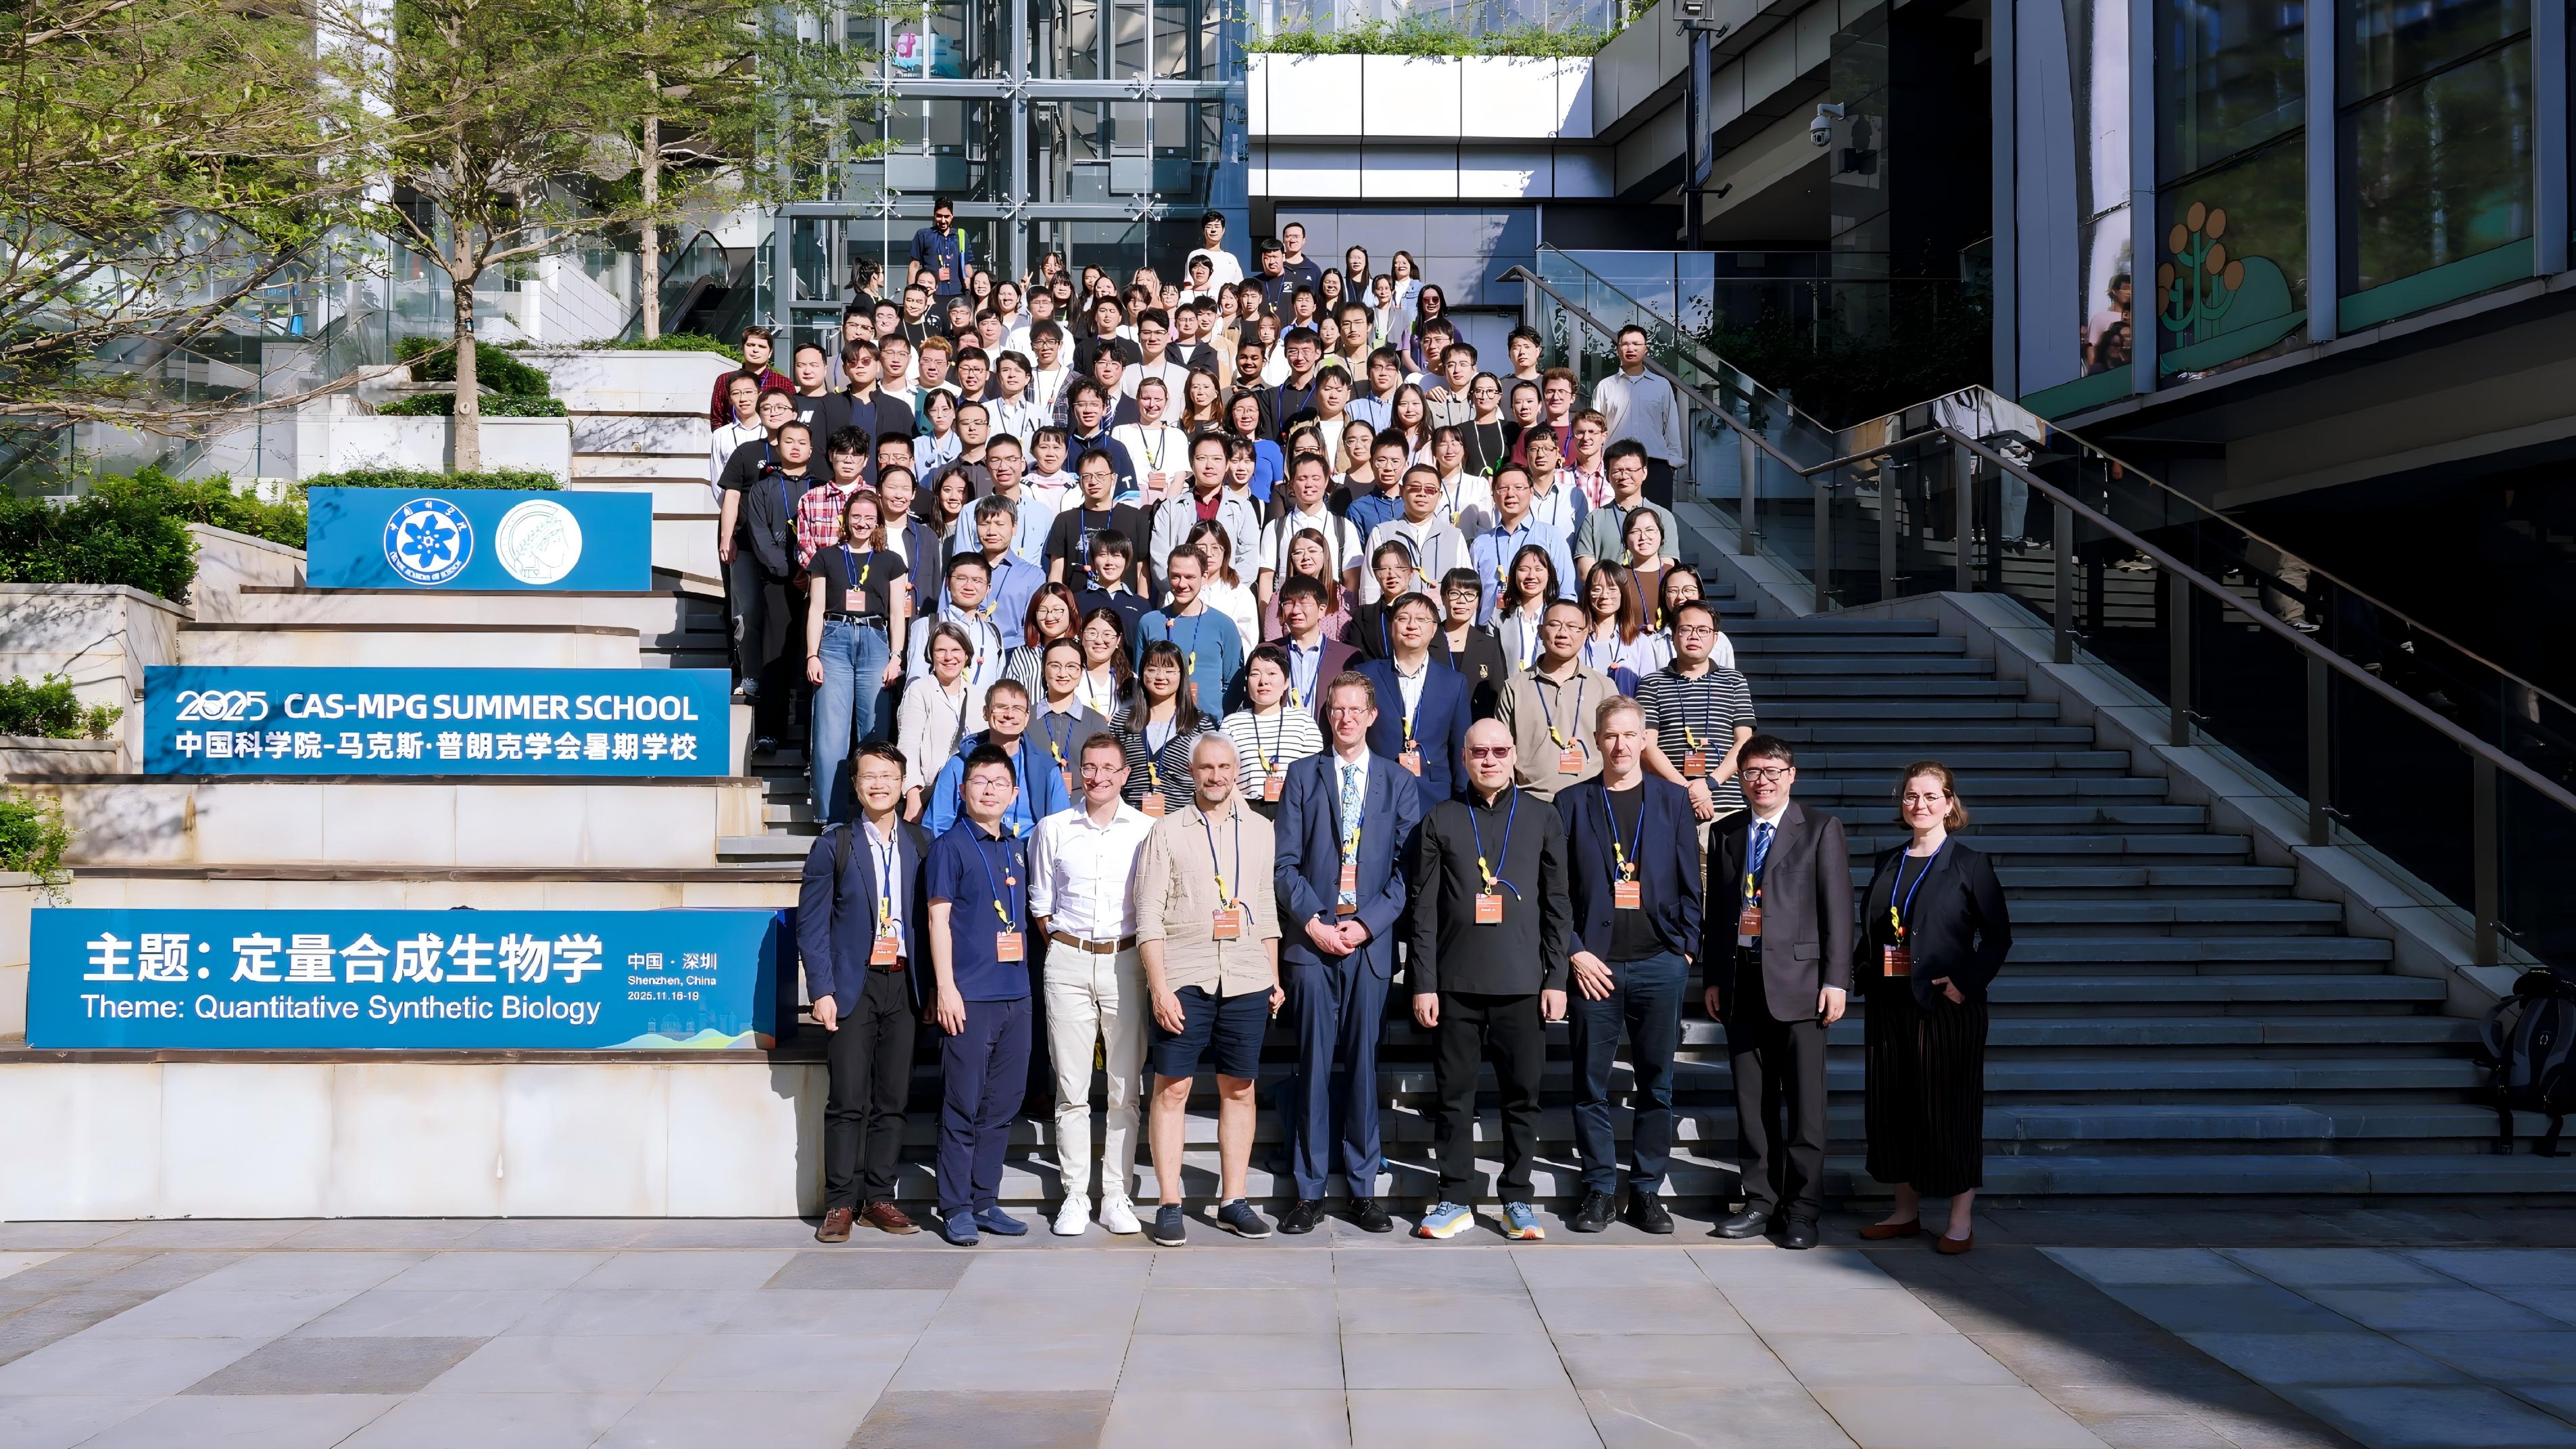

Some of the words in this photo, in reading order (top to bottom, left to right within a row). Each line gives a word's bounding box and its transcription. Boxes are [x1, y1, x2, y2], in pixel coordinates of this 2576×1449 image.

[176, 690, 268, 721] 2025
[284, 693, 427, 720] CAS-MPG
[433, 694, 570, 720] SUMMER
[575, 695, 699, 721] SCHOOL
[628, 975, 683, 987] Shenzhen,
[686, 975, 716, 985] China
[81, 994, 185, 1018] Theme:
[195, 994, 359, 1019] Quantitative
[368, 994, 493, 1025] Synthetic
[502, 995, 601, 1025] Biology
